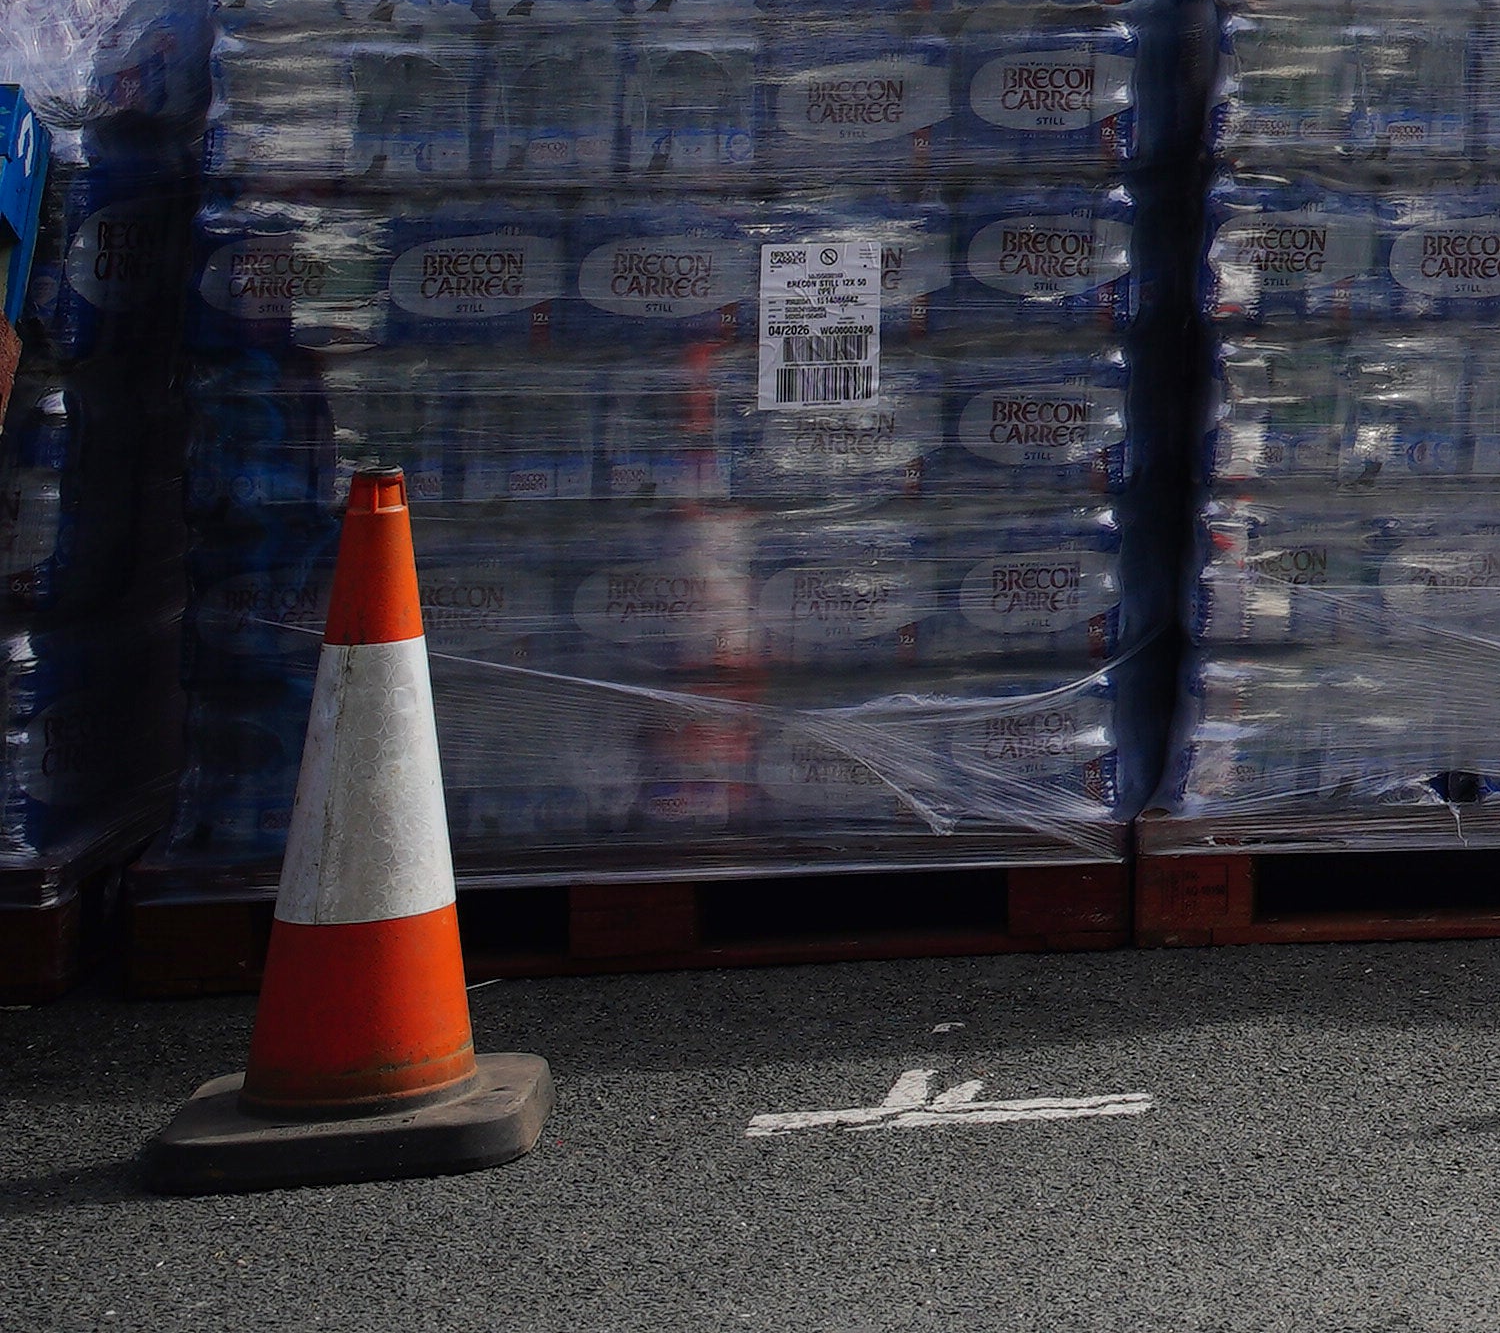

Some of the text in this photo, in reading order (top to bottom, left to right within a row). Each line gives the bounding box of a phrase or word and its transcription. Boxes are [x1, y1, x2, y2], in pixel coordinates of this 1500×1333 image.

[1036, 117, 1066, 125] STILL
[1002, 232, 1094, 254] BRECON
[423, 253, 523, 277] BRECON
[613, 253, 712, 276] BRECON
[1000, 255, 1091, 276] CARREG
[421, 277, 523, 300] CARREG
[610, 276, 711, 298] CARREG
[1263, 277, 1290, 288] STILL
[1454, 282, 1483, 292] STILL
[456, 304, 485, 313] STILL
[646, 303, 673, 313] STILL
[768, 325, 809, 336] 04/2026
[993, 401, 1088, 423] BRECON
[990, 424, 1085, 446] CARREG
